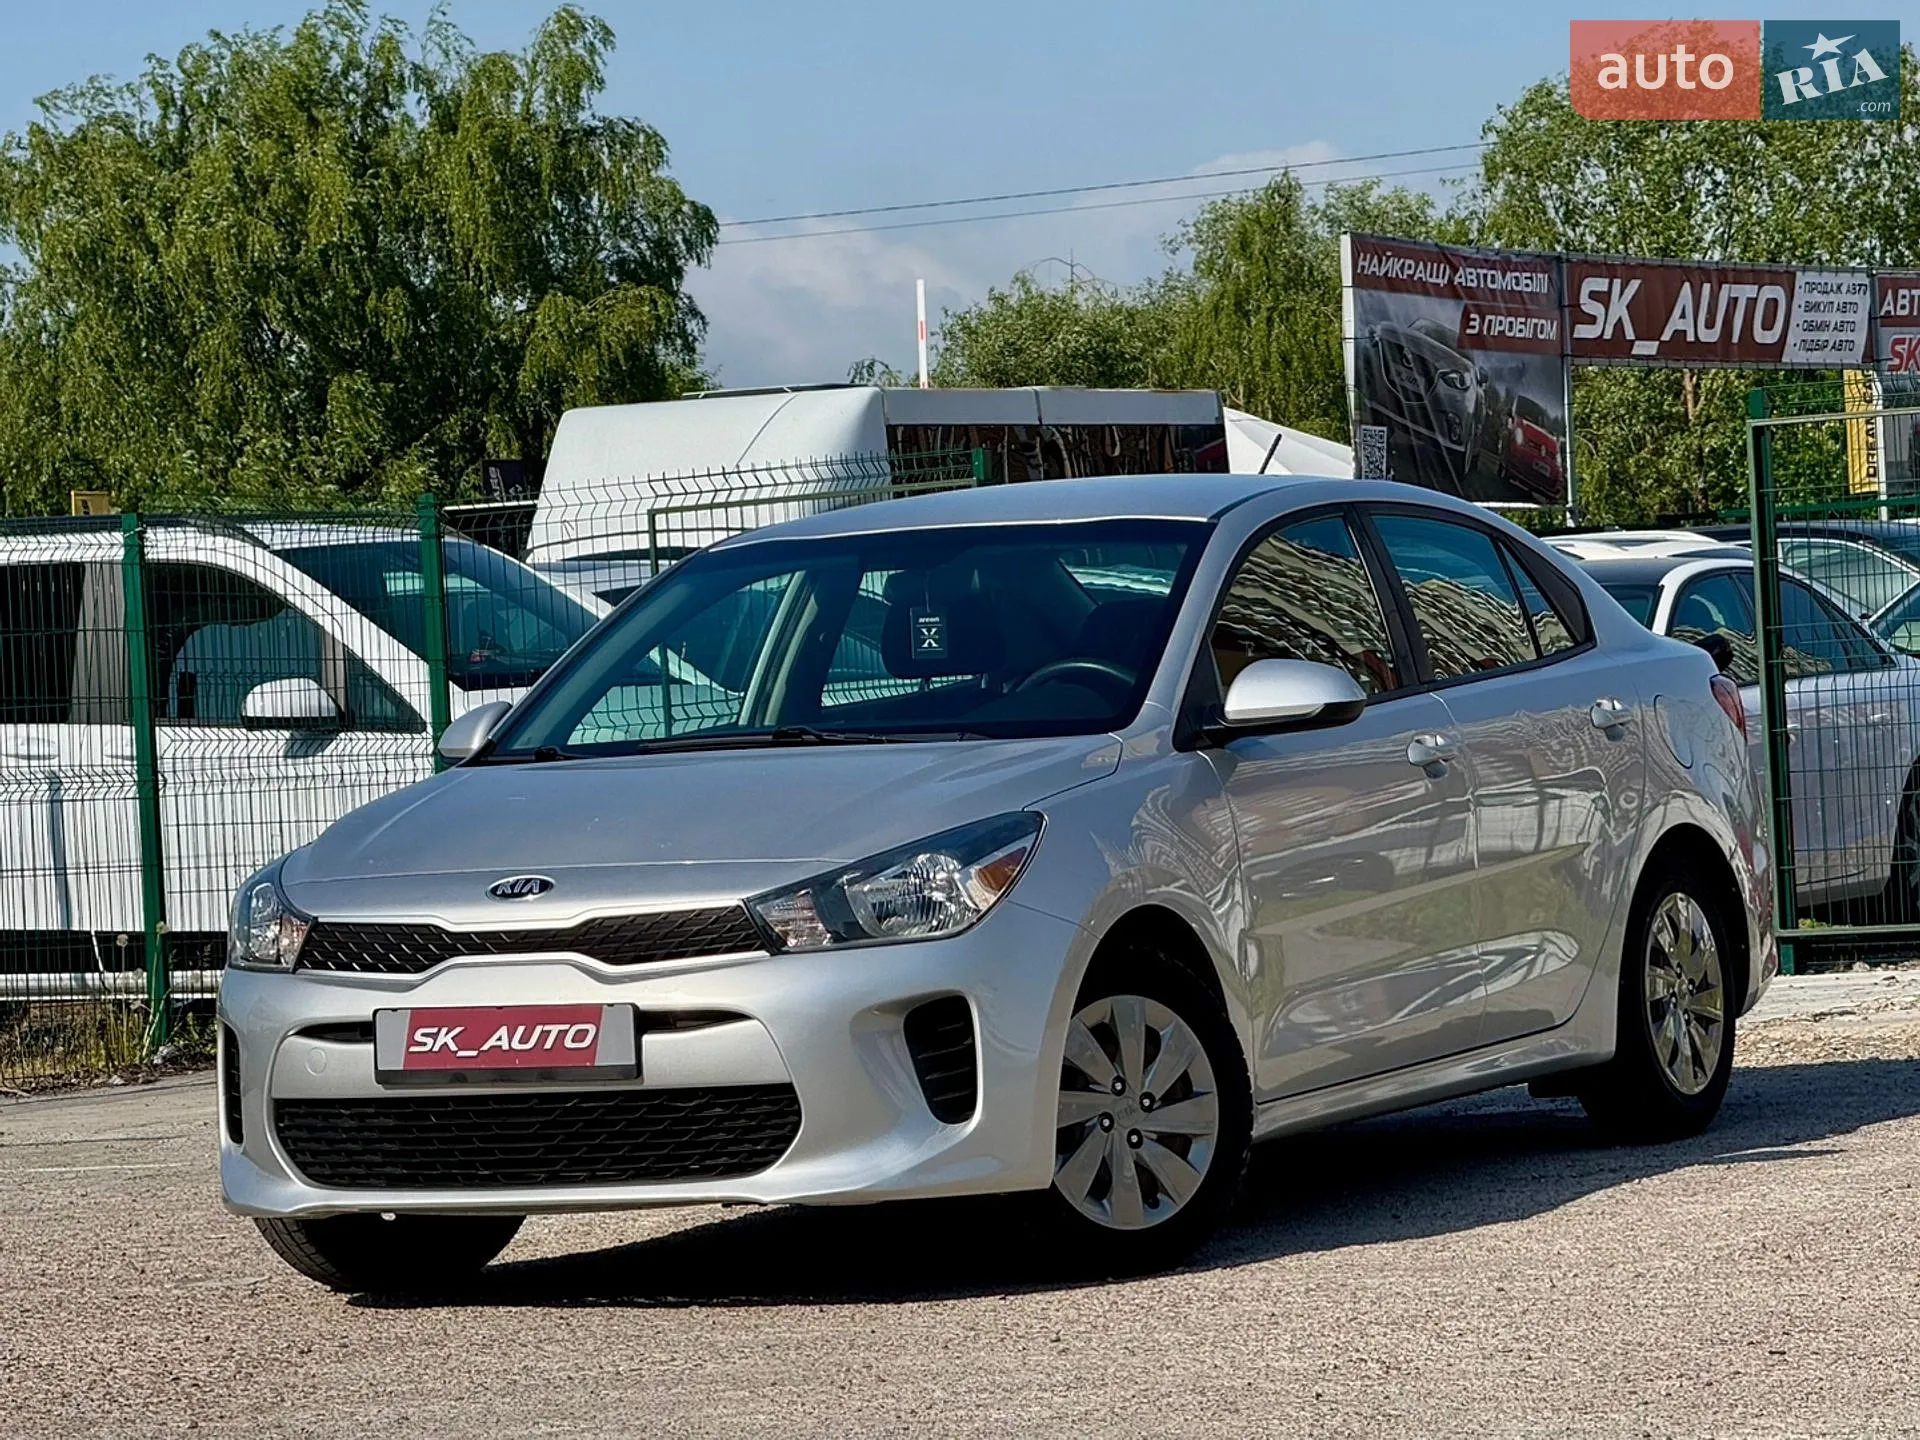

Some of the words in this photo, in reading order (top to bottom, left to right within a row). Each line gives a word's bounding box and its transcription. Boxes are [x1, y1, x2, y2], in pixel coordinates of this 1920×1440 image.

[1357, 251, 1449, 287] НАЙКРАЩІ
[1454, 267, 1549, 294] АВТОМОБІЛІ
[1803, 281, 1844, 296] ПРОДАЖ
[1803, 300, 1834, 314] ВИКУП
[1835, 301, 1859, 314] АВТО
[1573, 276, 1787, 356] SK_AUTO
[1482, 314, 1558, 341] ПРОБІГОМ
[1802, 319, 1831, 332] ОБМІН
[1831, 320, 1856, 333] АВТО
[1799, 338, 1829, 353] ПІДБІР
[1830, 339, 1855, 352] АВТО
[496, 879, 540, 895] KIA
[408, 1023, 597, 1058] SK_AUTO
